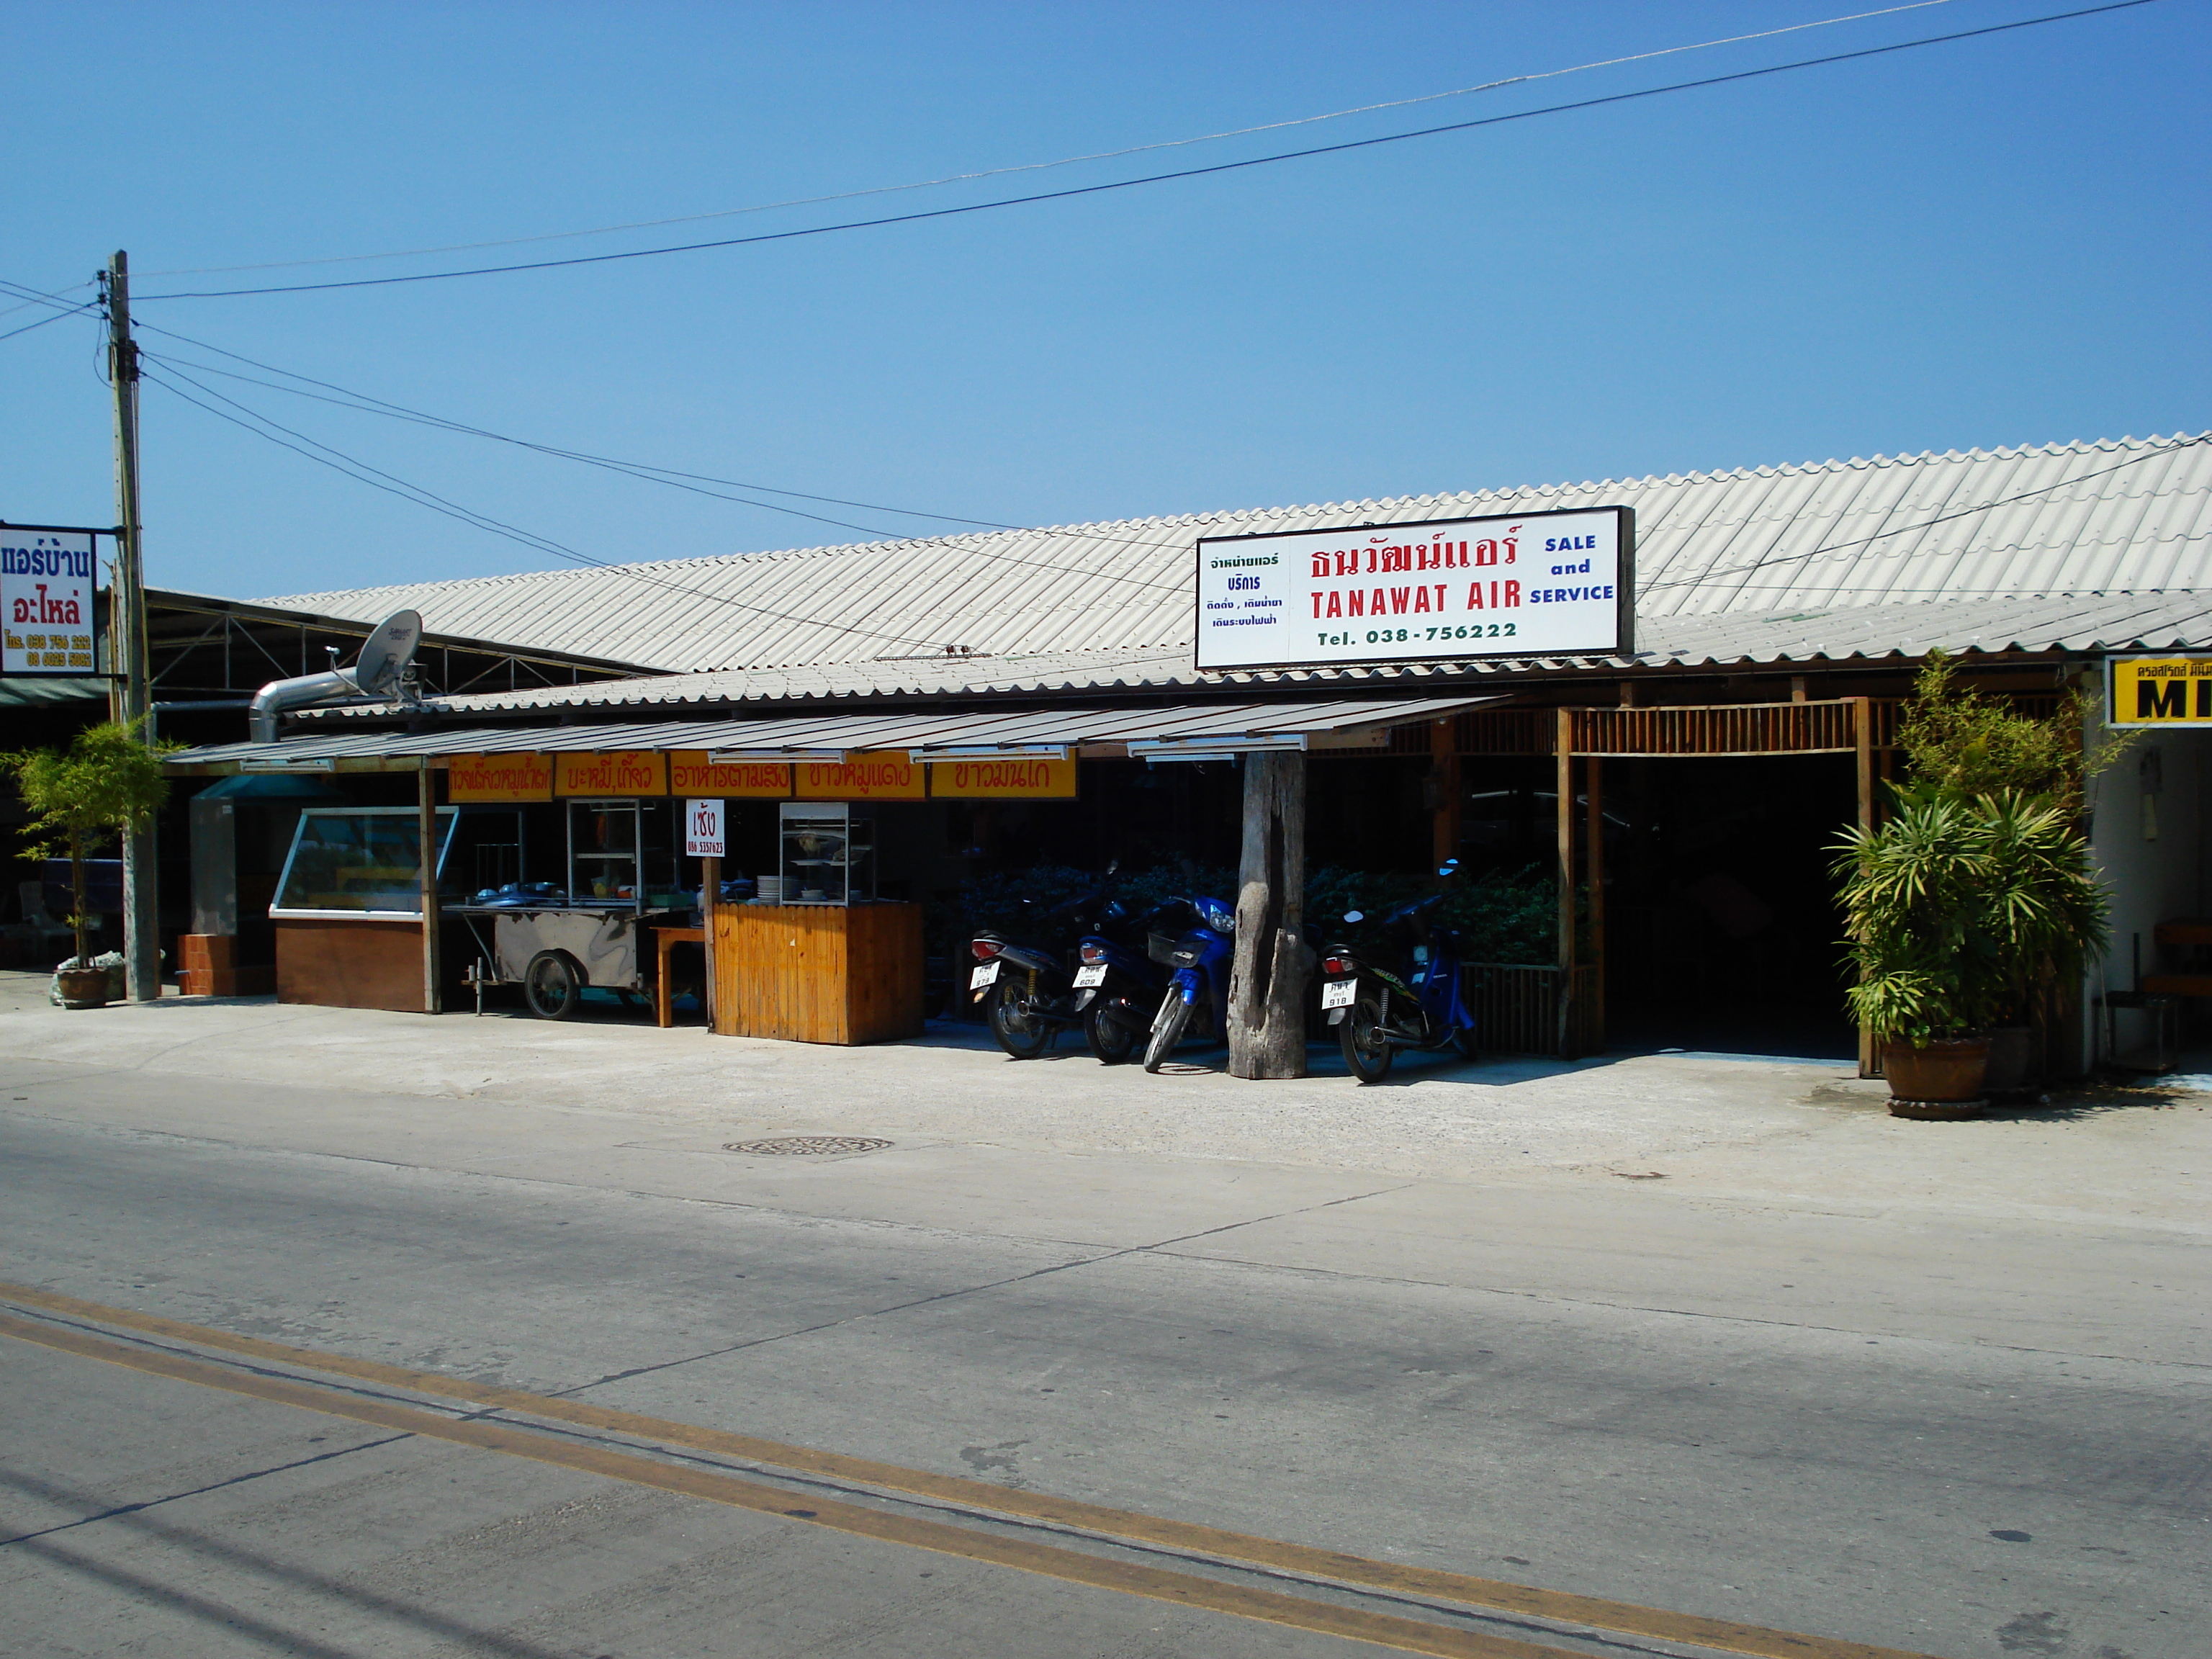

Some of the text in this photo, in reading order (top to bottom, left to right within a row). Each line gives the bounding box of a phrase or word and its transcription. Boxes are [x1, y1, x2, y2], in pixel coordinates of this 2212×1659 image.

[1310, 523, 1523, 577] ธนวัฒน์แอร์
[1545, 535, 1596, 552] SALE
[1, 538, 90, 578] แอร์บ้าน
[1210, 552, 1279, 569] จำหน่ายแอร์
[1551, 558, 1591, 575] and
[1228, 573, 1261, 591] บริการ
[1310, 579, 1521, 619] TANAWAT AIR
[1529, 585, 1614, 603] SERVICE
[13, 583, 81, 625] อะไหล่
[26, 634, 47, 649] 038
[48, 634, 69, 650] 756
[71, 635, 91, 650] 222
[1318, 622, 1517, 646] Tel. 038-756222
[27, 651, 40, 667] 08
[693, 801, 716, 837] เซ้ง
[1329, 997, 1346, 1007] 918
